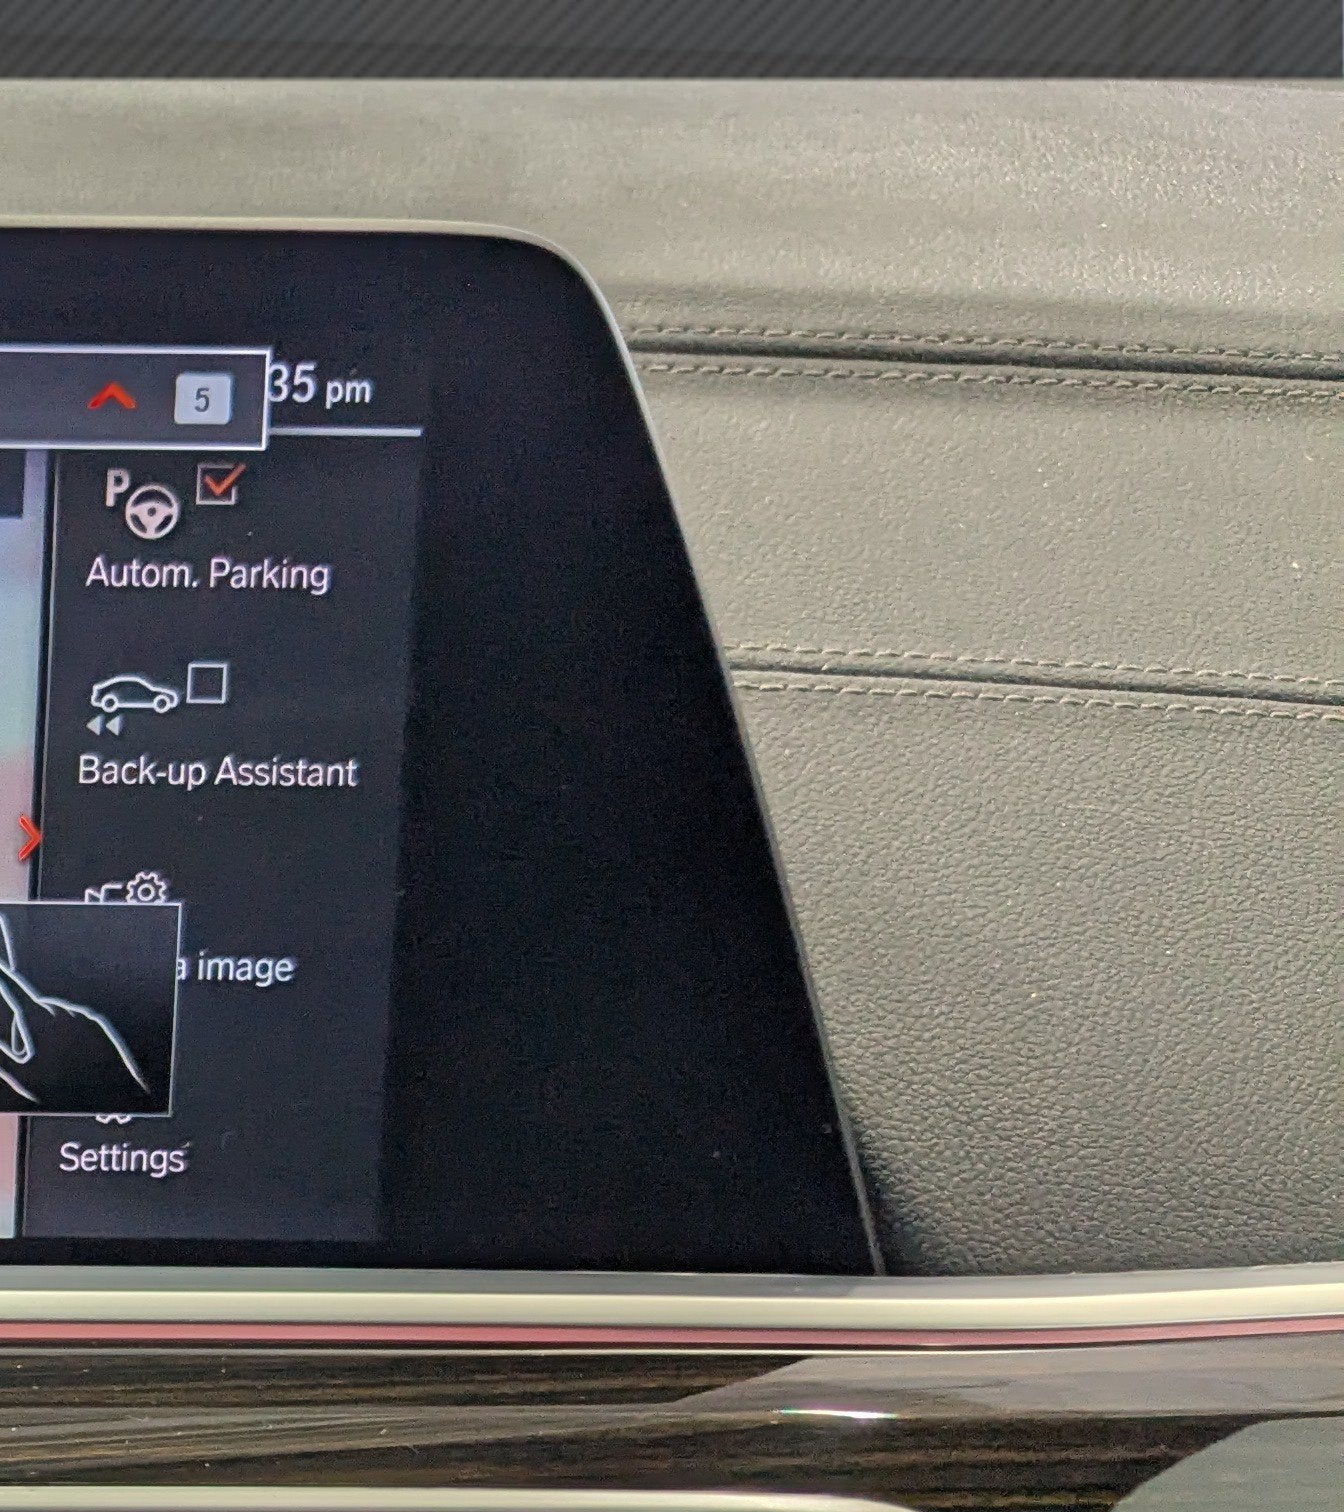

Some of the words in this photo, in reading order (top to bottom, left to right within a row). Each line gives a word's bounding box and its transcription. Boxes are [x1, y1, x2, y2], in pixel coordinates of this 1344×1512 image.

[193, 386, 212, 413] 5
[325, 379, 373, 410] pm
[85, 555, 200, 588] Autom.
[209, 555, 331, 596] Parking
[78, 753, 207, 792] Back-up
[213, 754, 359, 788] Assistant
[196, 949, 296, 989] image
[58, 1140, 187, 1179] Settings
